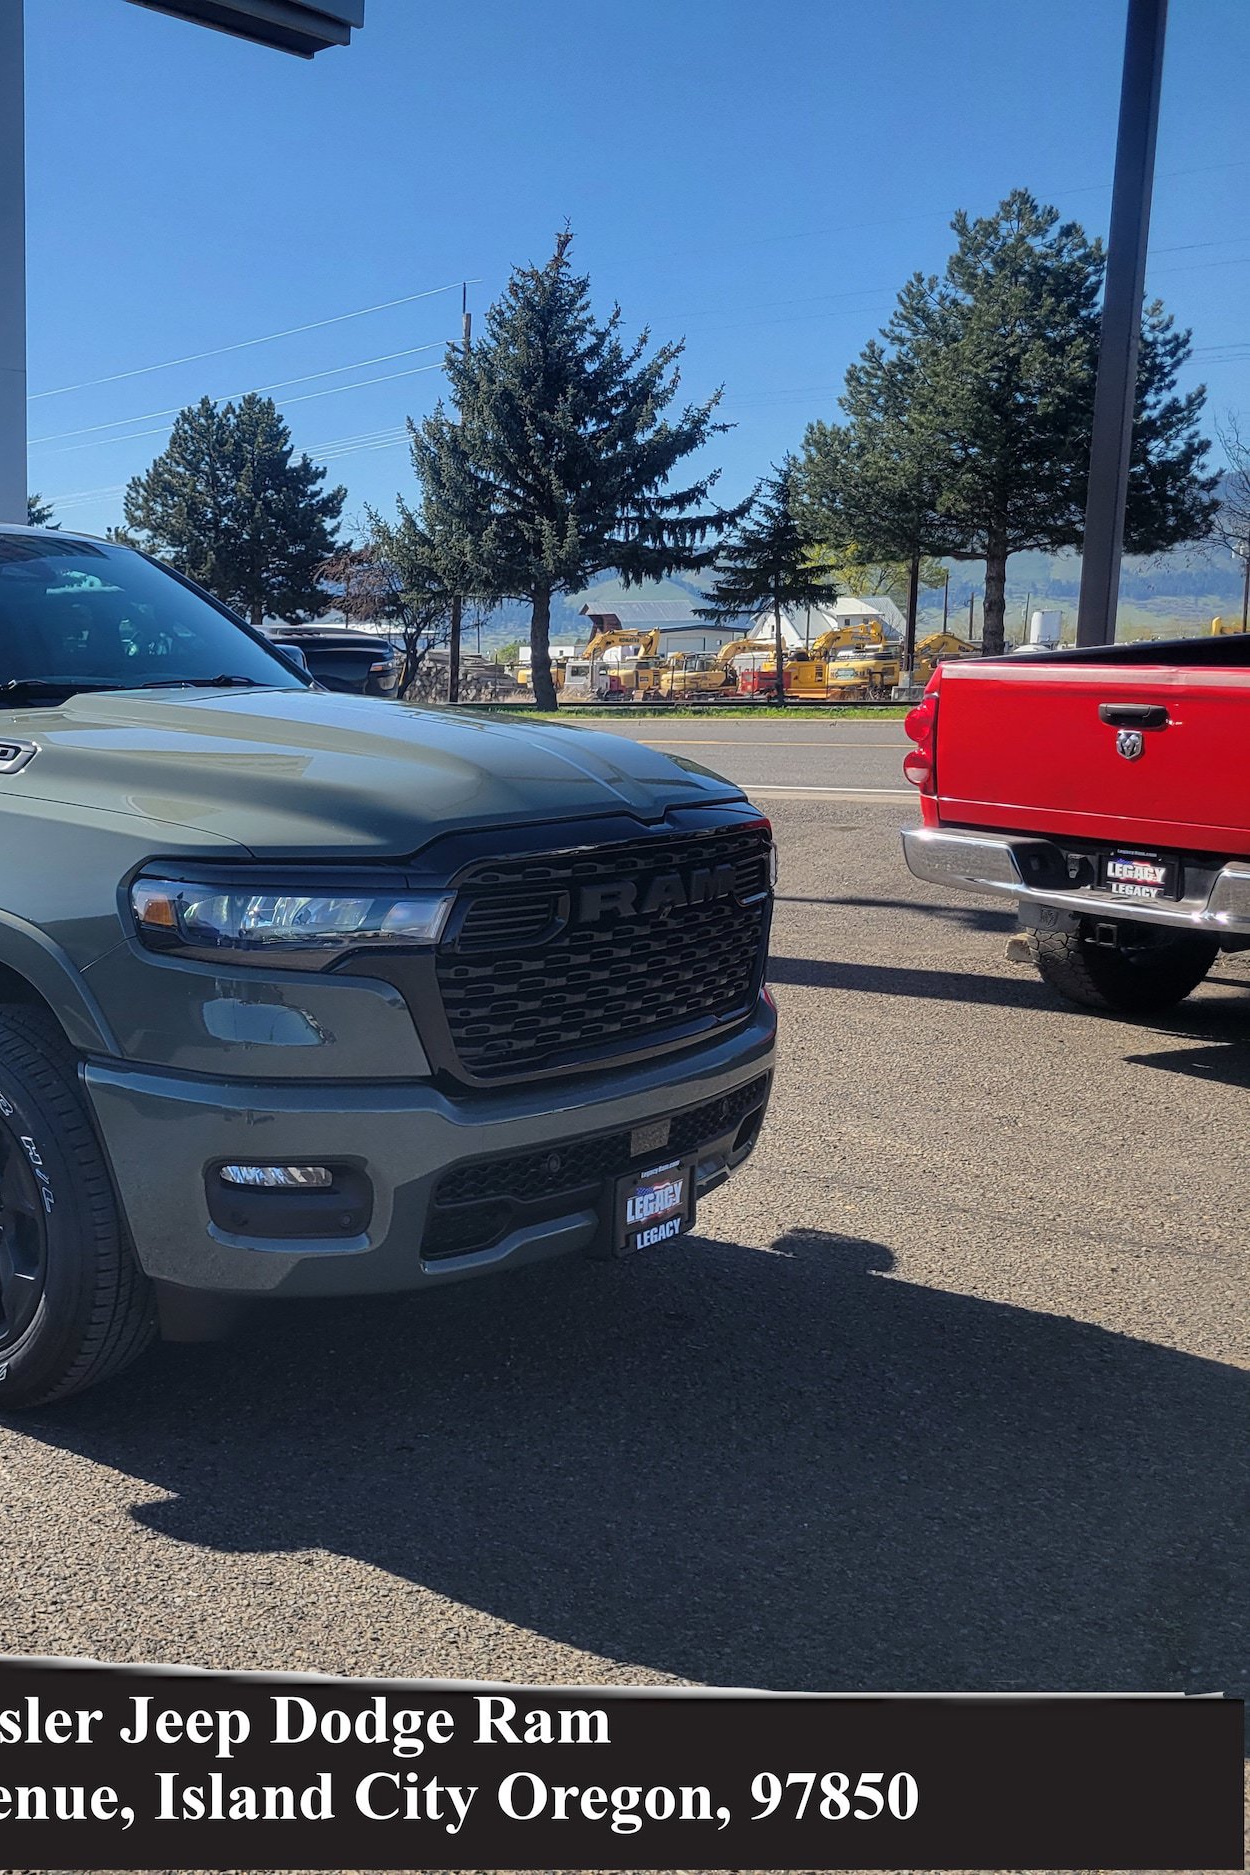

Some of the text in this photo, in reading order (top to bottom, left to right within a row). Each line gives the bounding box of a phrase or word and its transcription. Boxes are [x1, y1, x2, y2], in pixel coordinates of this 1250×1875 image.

[1107, 861, 1166, 882] LEGACY
[579, 862, 736, 923] RAM
[1111, 883, 1158, 898] LEGACY
[625, 1181, 684, 1224] LEGACY
[636, 1217, 682, 1250] LEGACY
